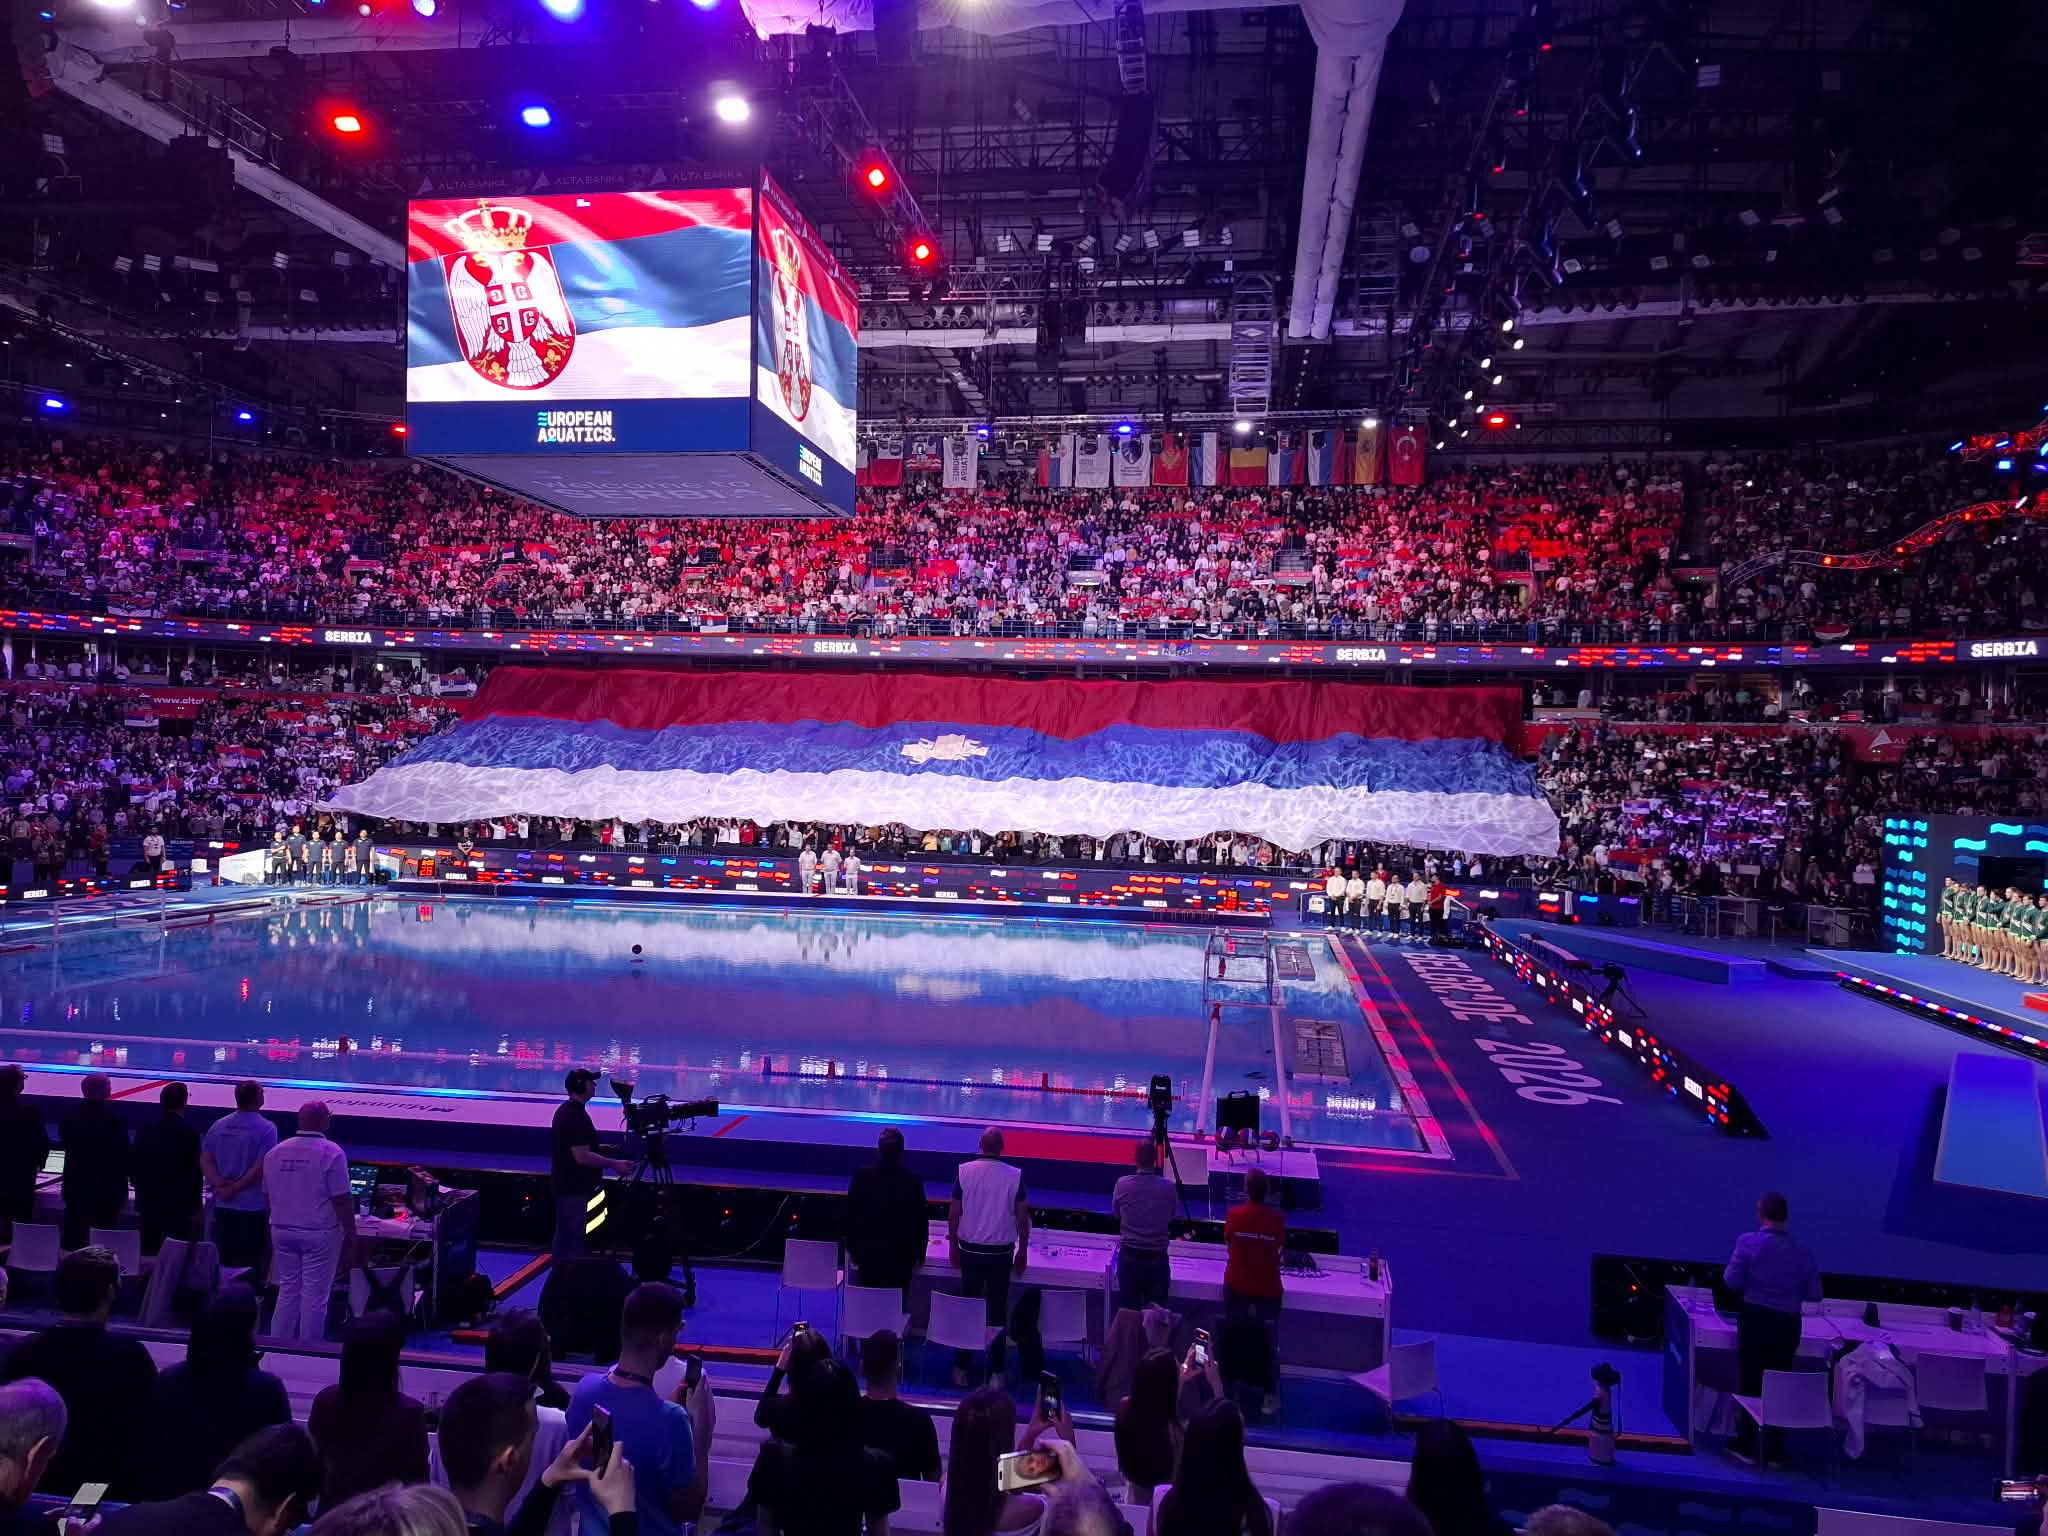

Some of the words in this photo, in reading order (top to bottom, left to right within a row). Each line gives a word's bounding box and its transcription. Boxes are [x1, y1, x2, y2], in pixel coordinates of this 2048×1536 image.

[554, 173, 624, 188] ALTABANKA
[537, 411, 612, 427] EUROPEAN
[325, 630, 372, 643] SERBIA
[813, 640, 858, 654] SERBIA
[1336, 647, 1387, 661] SERBIA
[1971, 641, 2038, 657] SERBIA
[1473, 1038, 1624, 1105] 2026
